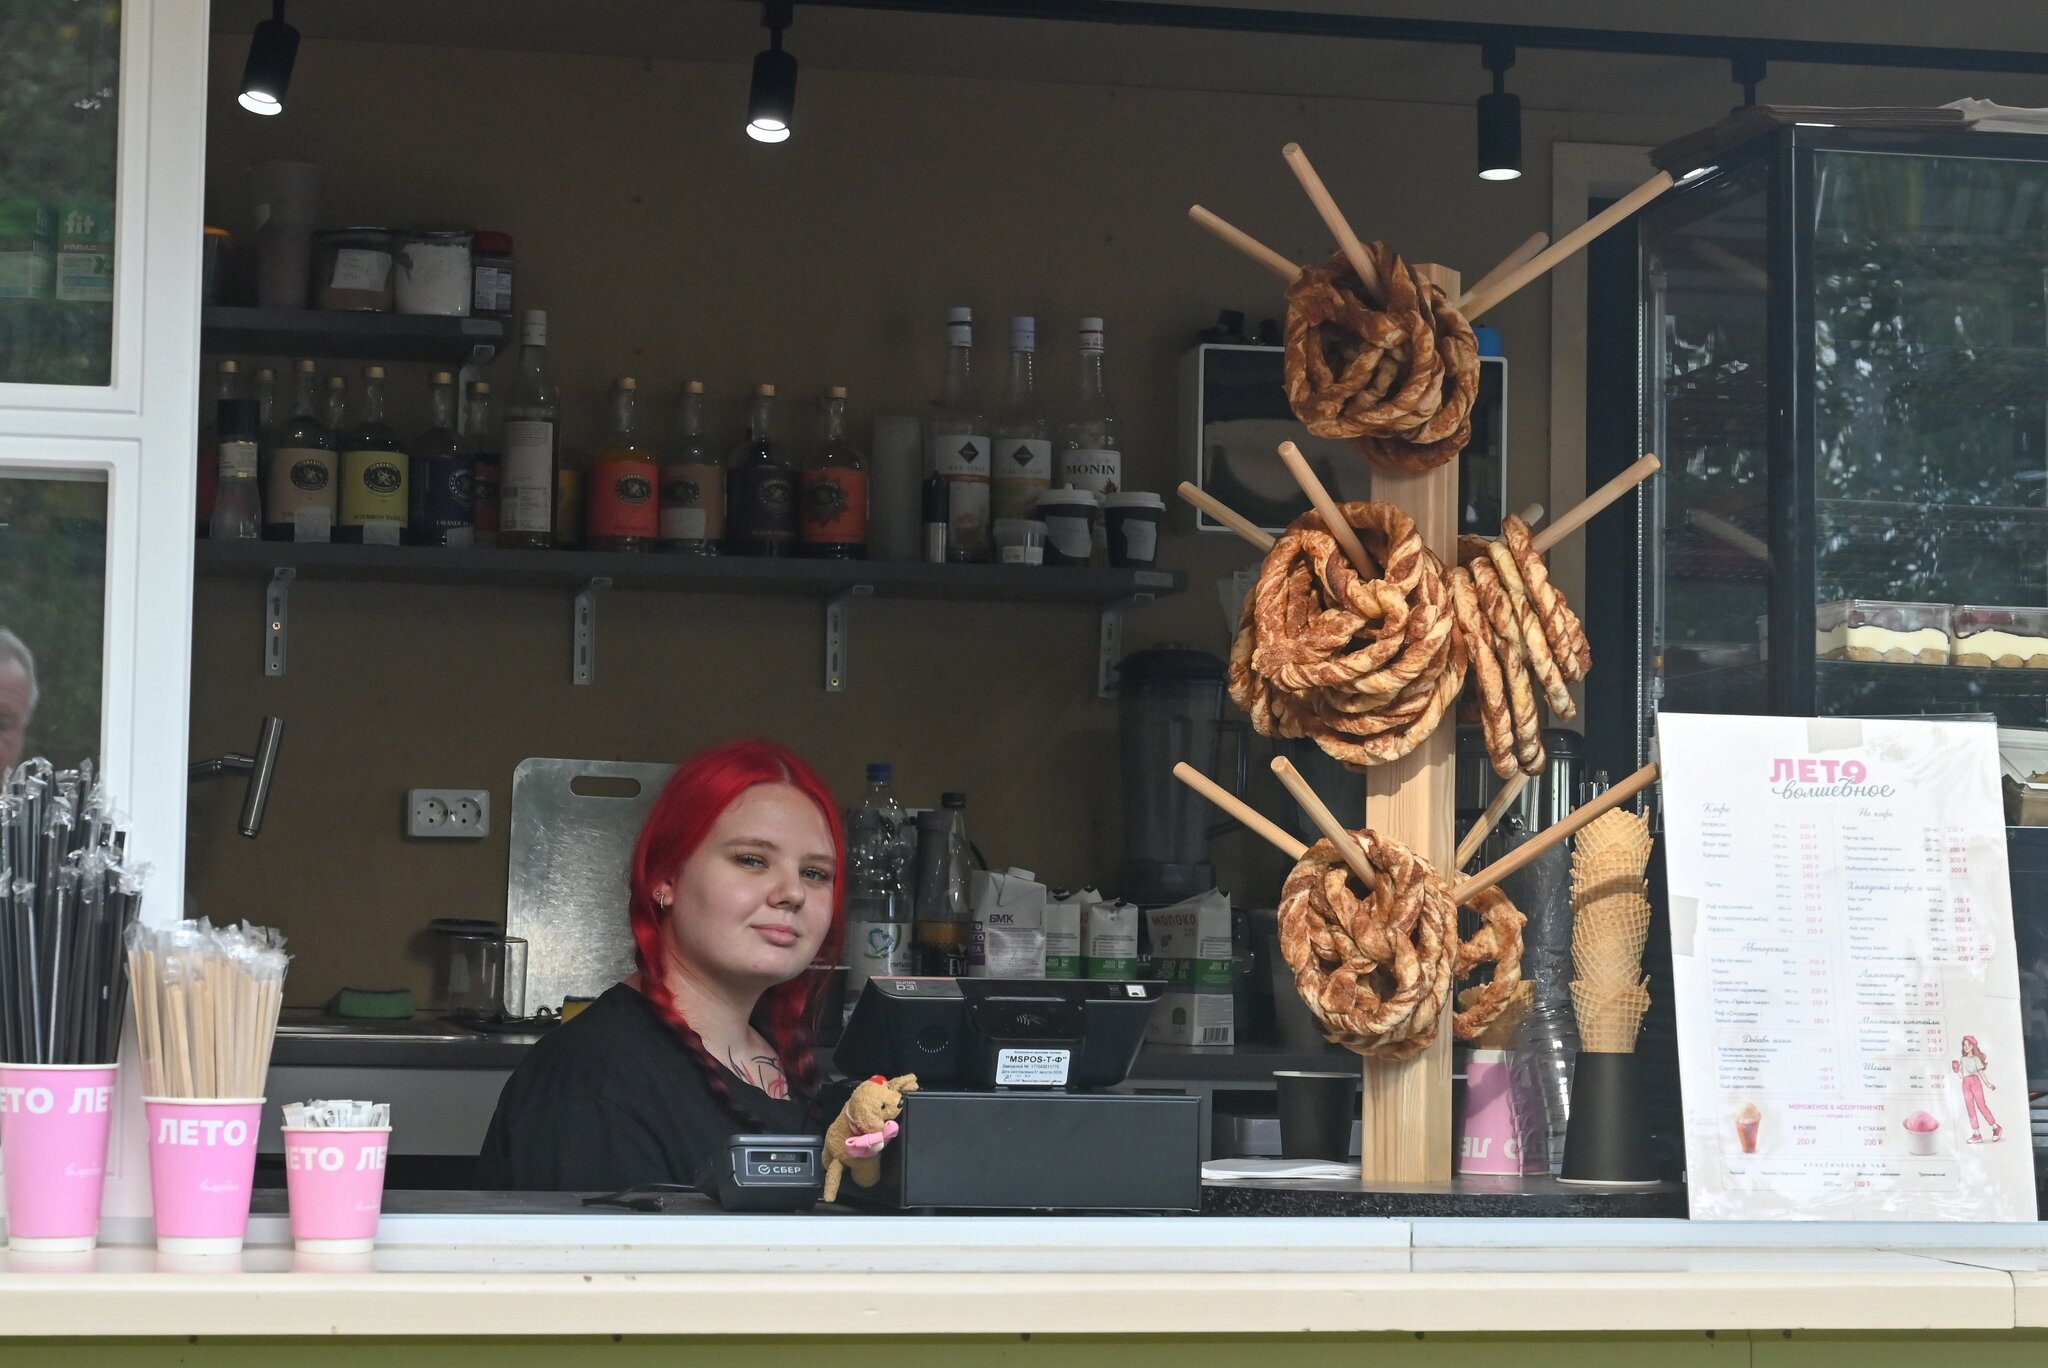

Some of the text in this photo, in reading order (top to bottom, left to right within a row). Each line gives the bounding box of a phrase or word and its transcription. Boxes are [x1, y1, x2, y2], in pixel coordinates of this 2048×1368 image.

[65, 210, 95, 234] fit
[1065, 463, 1115, 475] MONIN
[1770, 758, 1868, 785] ЛЕТО
[1772, 777, 1896, 799] волшебное
[989, 914, 1014, 924] БМК
[1151, 913, 1197, 927] МОЛОКО
[1743, 942, 1791, 957] Авторские
[1836, 1104, 1886, 1112] АССОРТИМЕНТЕ
[158, 1118, 248, 1146] ЛЕТО
[1796, 1138, 1810, 1146] 200
[1863, 1139, 1877, 1147] 200
[286, 1146, 345, 1171] ЕТО
[772, 1166, 802, 1174] СБЕР
[1854, 1180, 1866, 1188] 100
